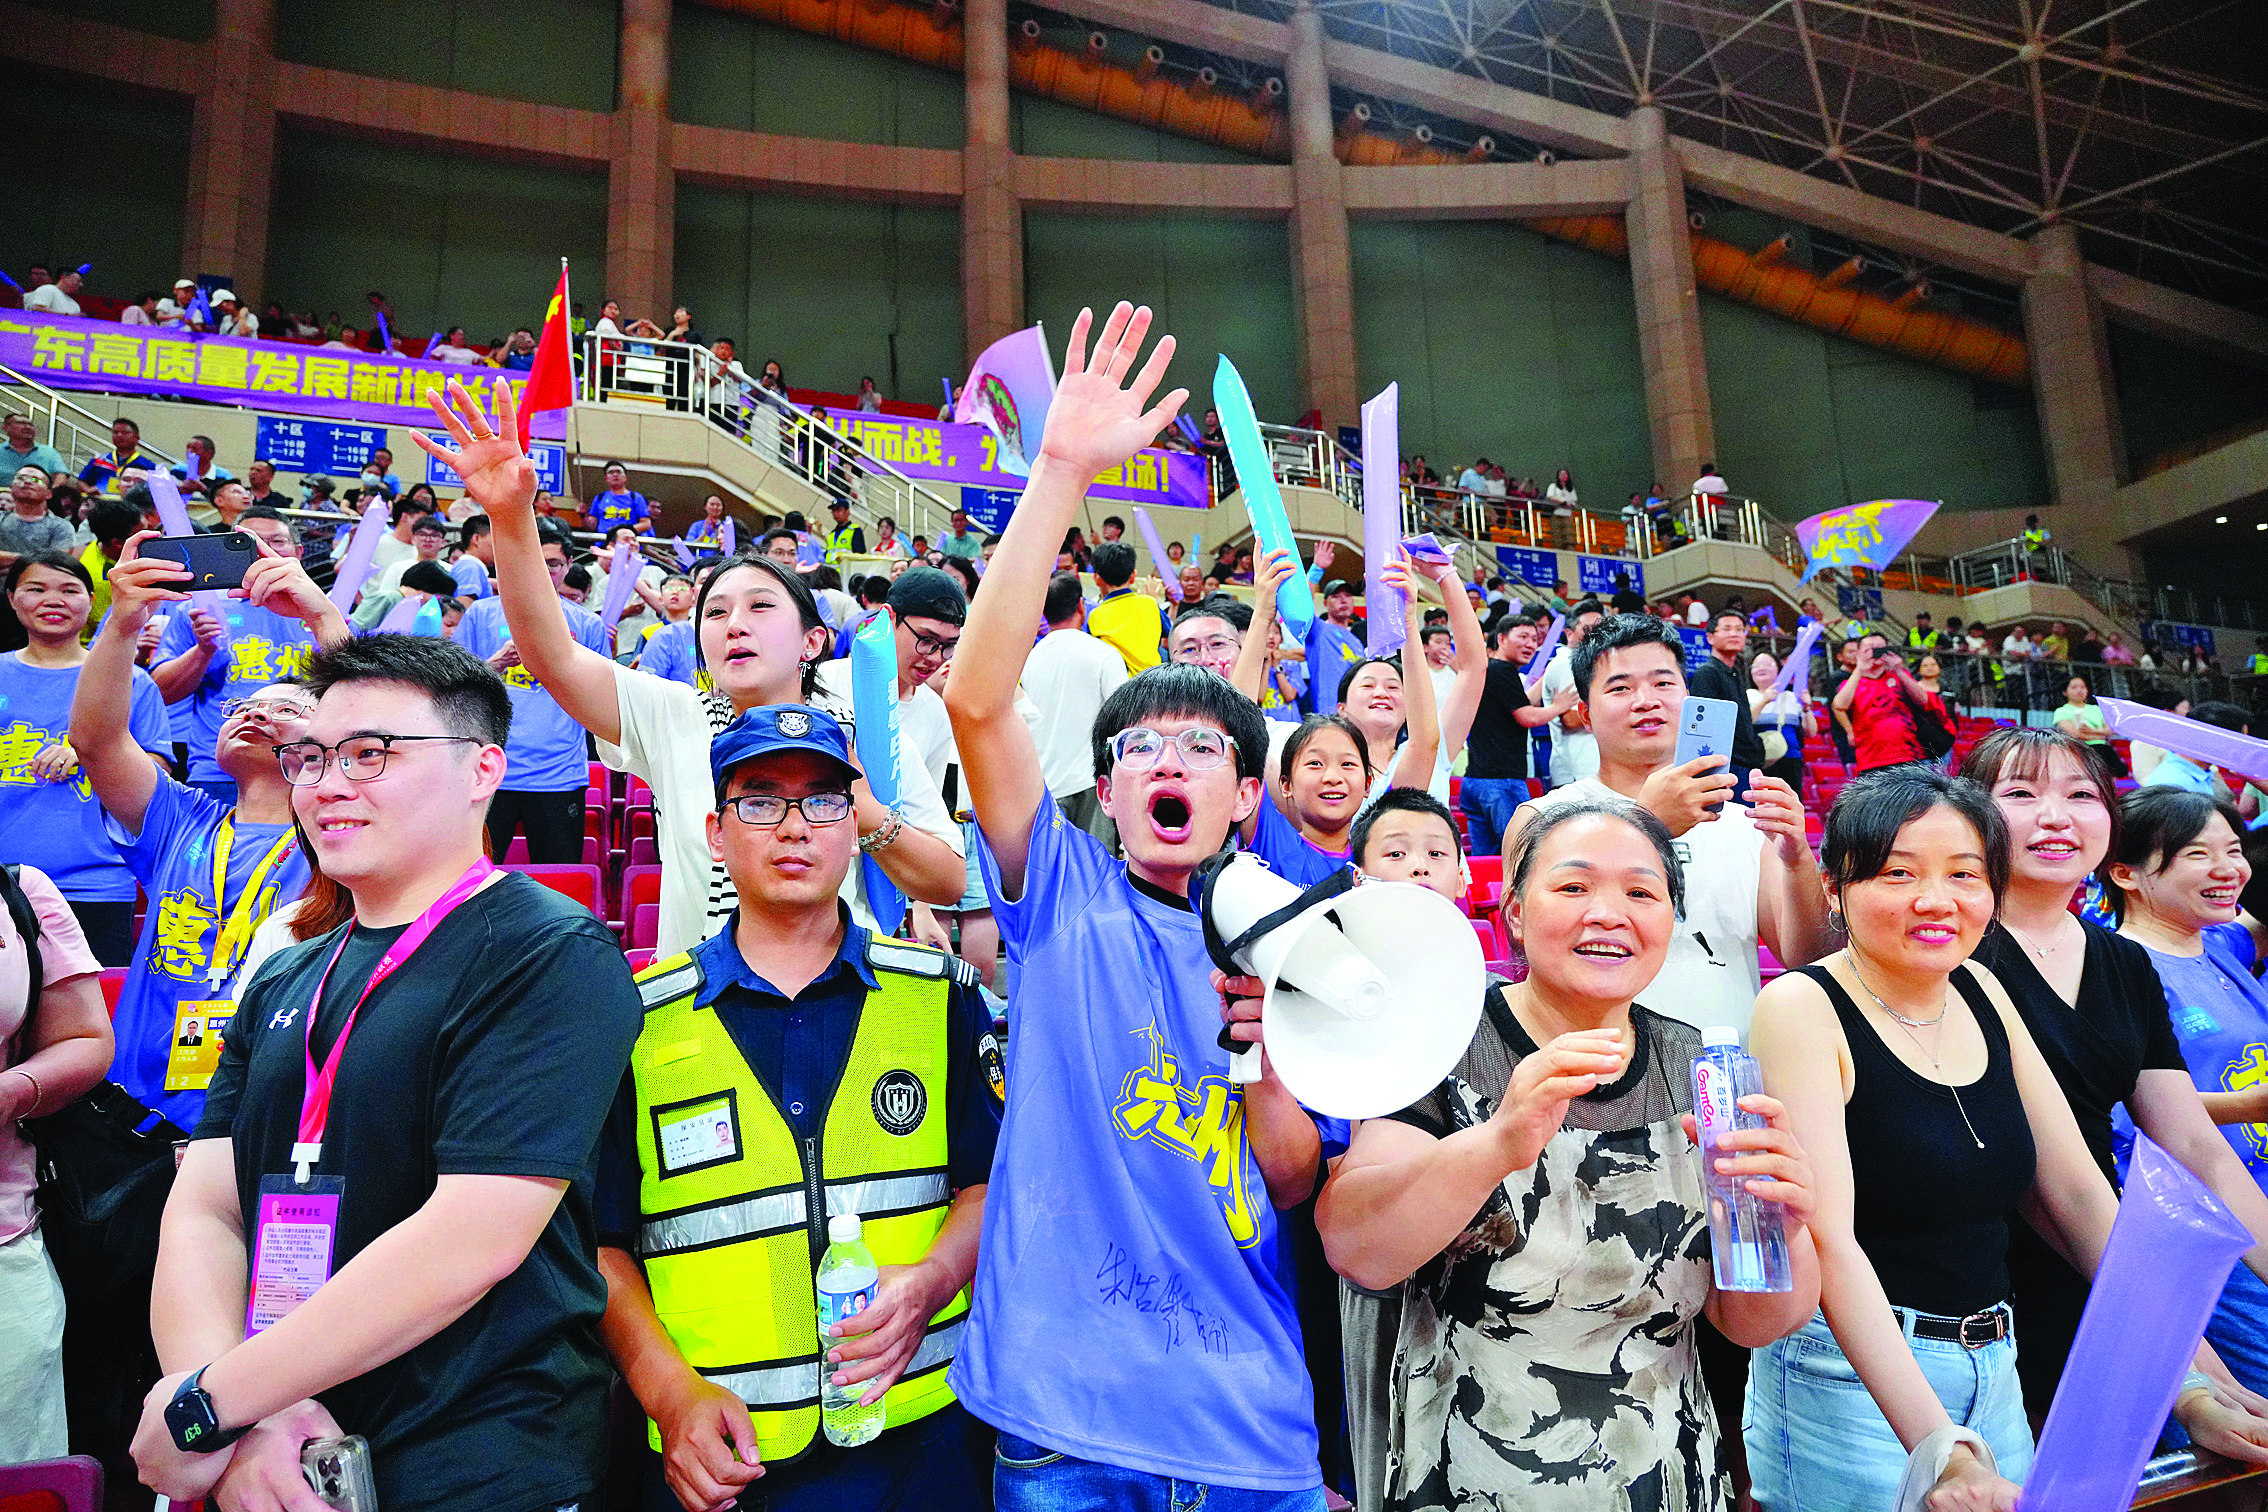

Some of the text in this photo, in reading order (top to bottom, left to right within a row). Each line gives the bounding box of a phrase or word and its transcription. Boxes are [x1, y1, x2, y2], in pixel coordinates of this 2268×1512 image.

[273, 421, 304, 436] 十区
[330, 427, 374, 444] 十一区
[230, 636, 314, 682] 惠州
[184, 1422, 202, 1443] 9:37
